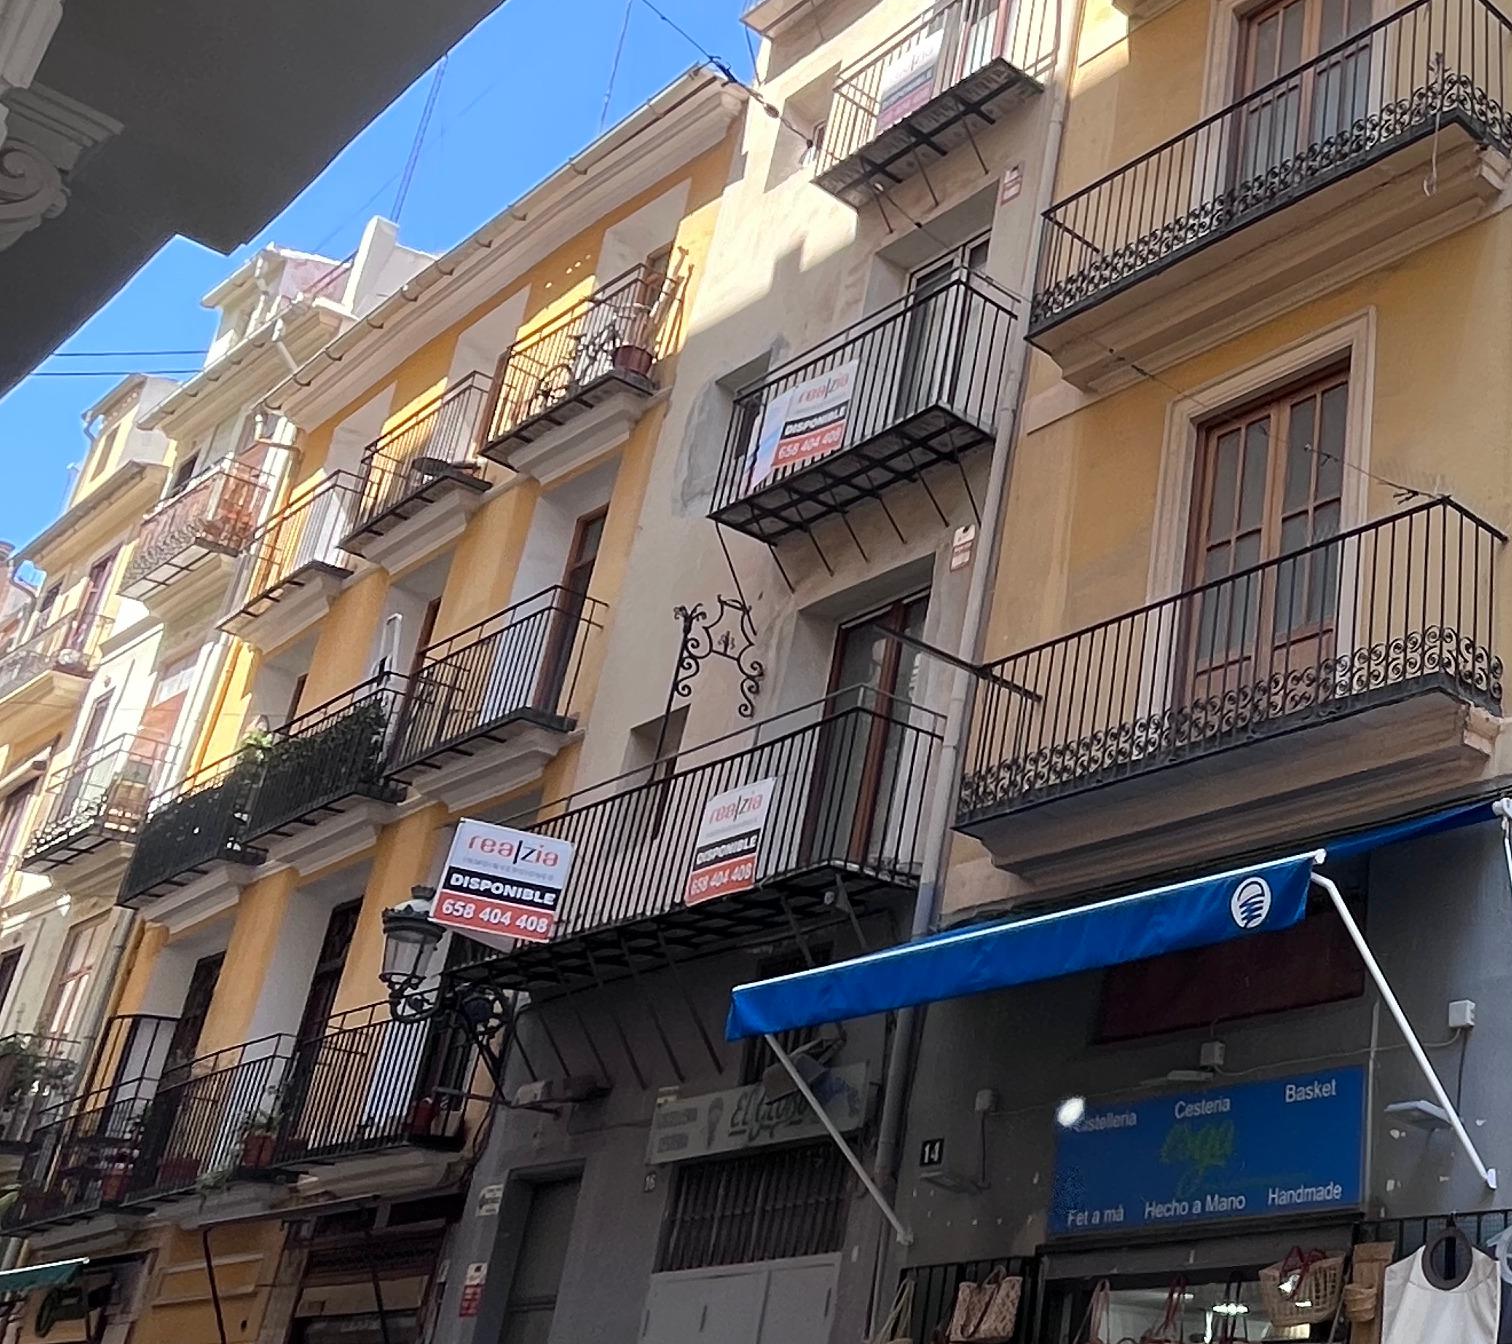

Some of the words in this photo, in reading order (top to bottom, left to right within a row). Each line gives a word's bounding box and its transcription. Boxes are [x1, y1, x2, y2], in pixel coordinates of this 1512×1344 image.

[697, 835, 758, 864] DISPONIBLE
[449, 872, 556, 905] DISPONIBLE
[441, 899, 475, 919] 658
[479, 907, 512, 926] 404
[515, 914, 548, 934] 408
[1285, 1078, 1337, 1103] Basket
[924, 1141, 940, 1163] 14
[1267, 1181, 1342, 1206] Handmade
[1091, 1209, 1100, 1224] a
[1145, 1199, 1189, 1220] Hecho
[1192, 1201, 1201, 1213] a
[1205, 1194, 1246, 1213] Mano
